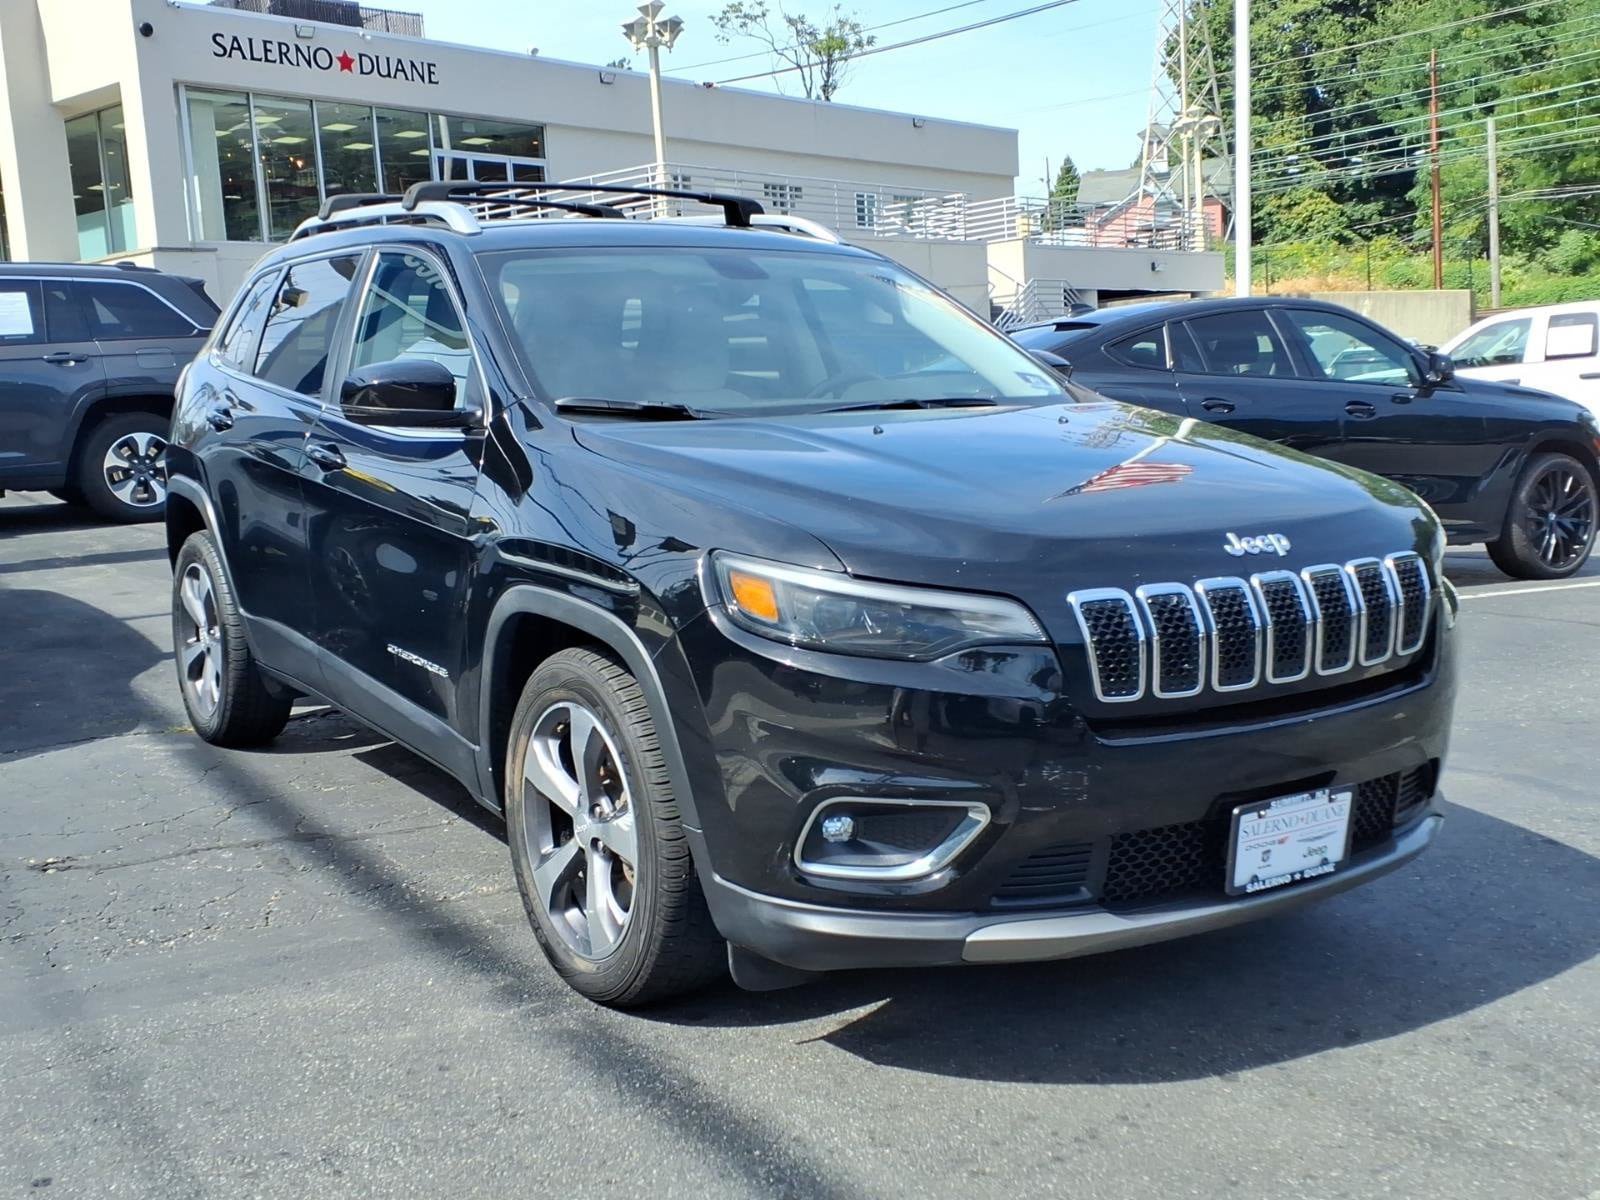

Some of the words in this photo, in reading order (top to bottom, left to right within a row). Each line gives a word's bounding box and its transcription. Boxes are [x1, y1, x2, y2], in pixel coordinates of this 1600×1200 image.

[212, 32, 333, 71] SALERNO
[358, 53, 440, 85] DUANE
[1223, 532, 1292, 557] Jeep
[386, 643, 449, 678] CHEROKEE
[1241, 816, 1300, 840] SALERNO
[1304, 803, 1345, 825] DUANE
